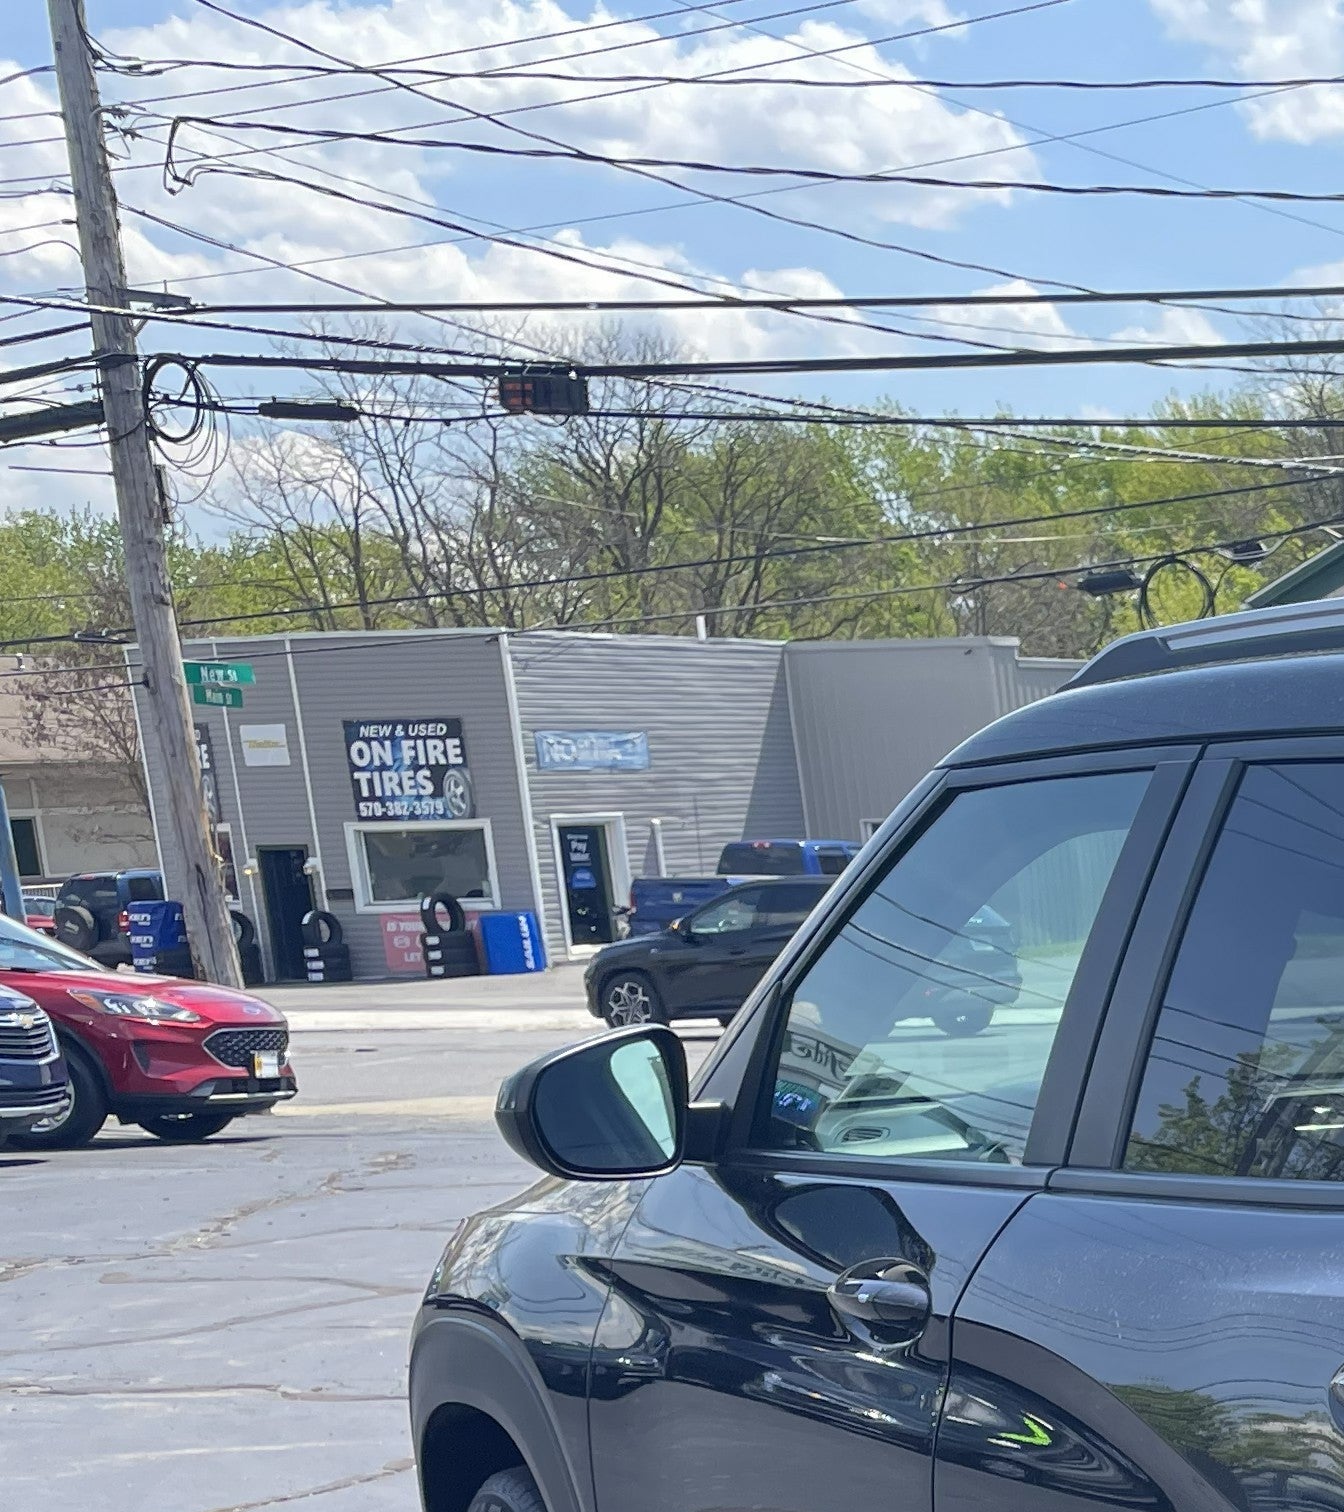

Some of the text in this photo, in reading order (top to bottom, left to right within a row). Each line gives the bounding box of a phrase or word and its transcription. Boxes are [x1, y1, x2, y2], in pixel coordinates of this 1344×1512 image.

[200, 666, 238, 681] New St
[359, 722, 447, 737] NEW & USED
[350, 737, 463, 767] ON FIRE
[353, 769, 434, 798] TIRES
[359, 799, 444, 817] 570-382-3579
